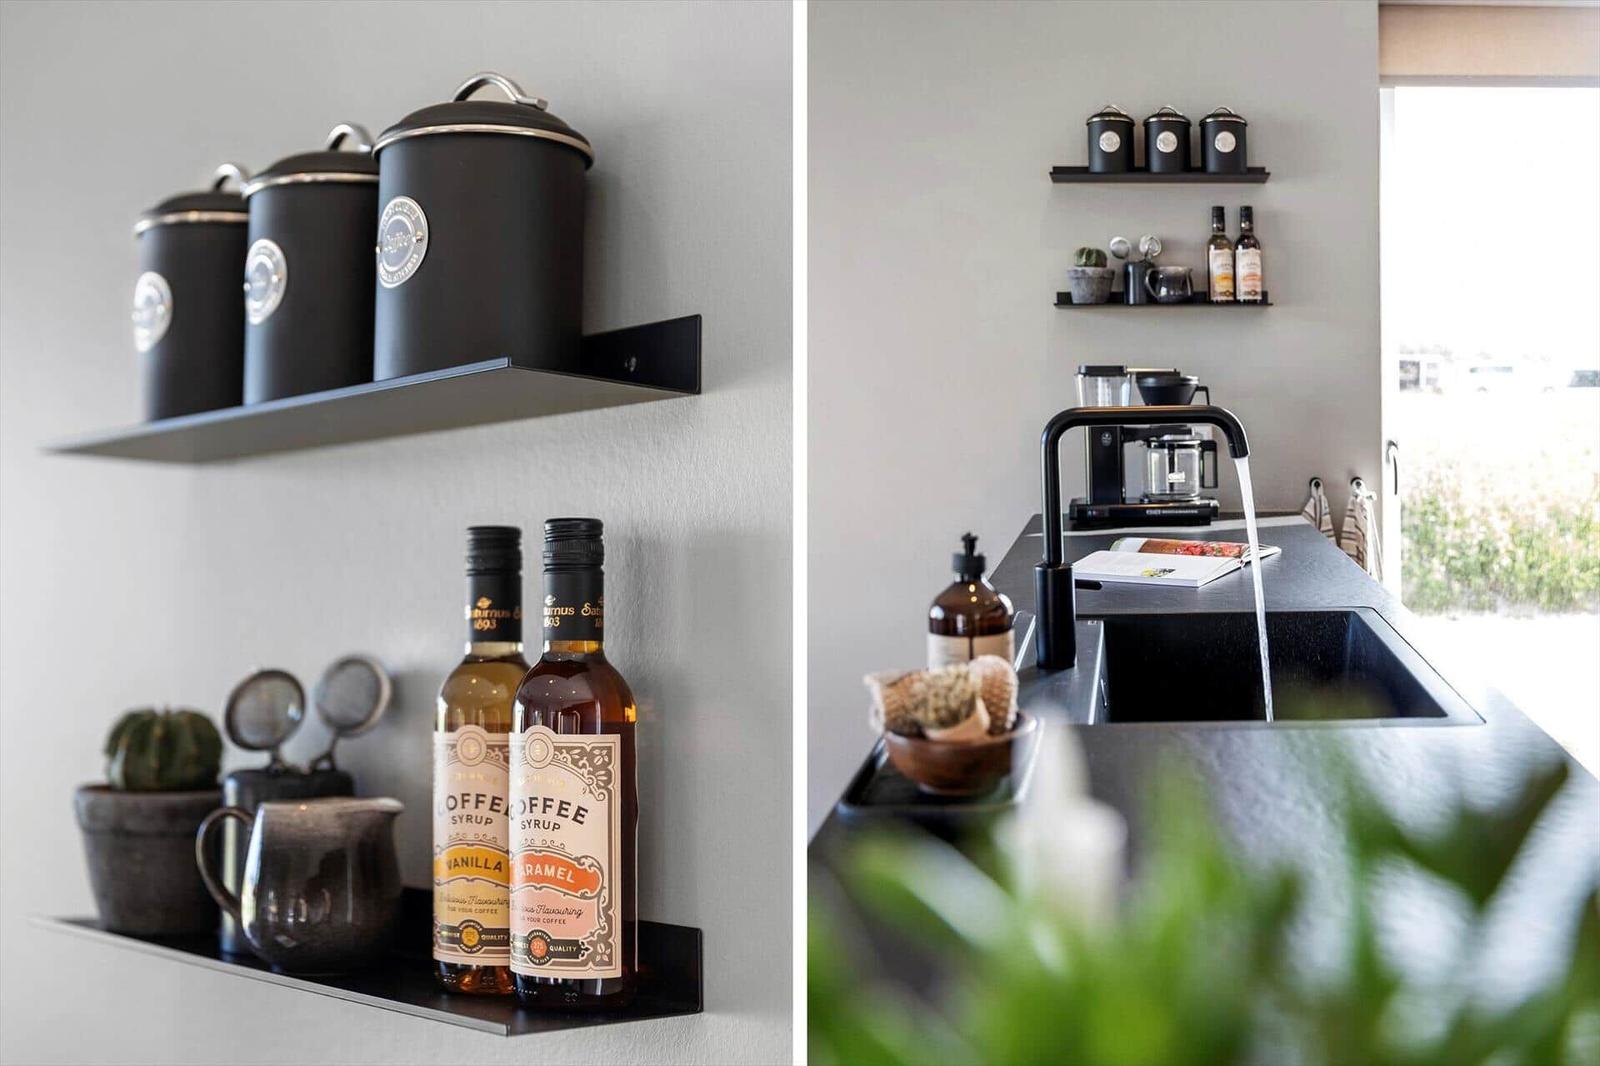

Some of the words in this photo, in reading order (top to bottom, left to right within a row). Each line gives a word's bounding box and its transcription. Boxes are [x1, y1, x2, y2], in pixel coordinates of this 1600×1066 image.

[438, 792, 509, 818] OFFE
[451, 814, 493, 826] SYRUP
[521, 818, 561, 832] SYRUP
[447, 856, 502, 872] VANILLA
[516, 863, 576, 884] ARAMEL
[535, 904, 584, 919] Flavouring
[481, 933, 508, 941] QUALITY
